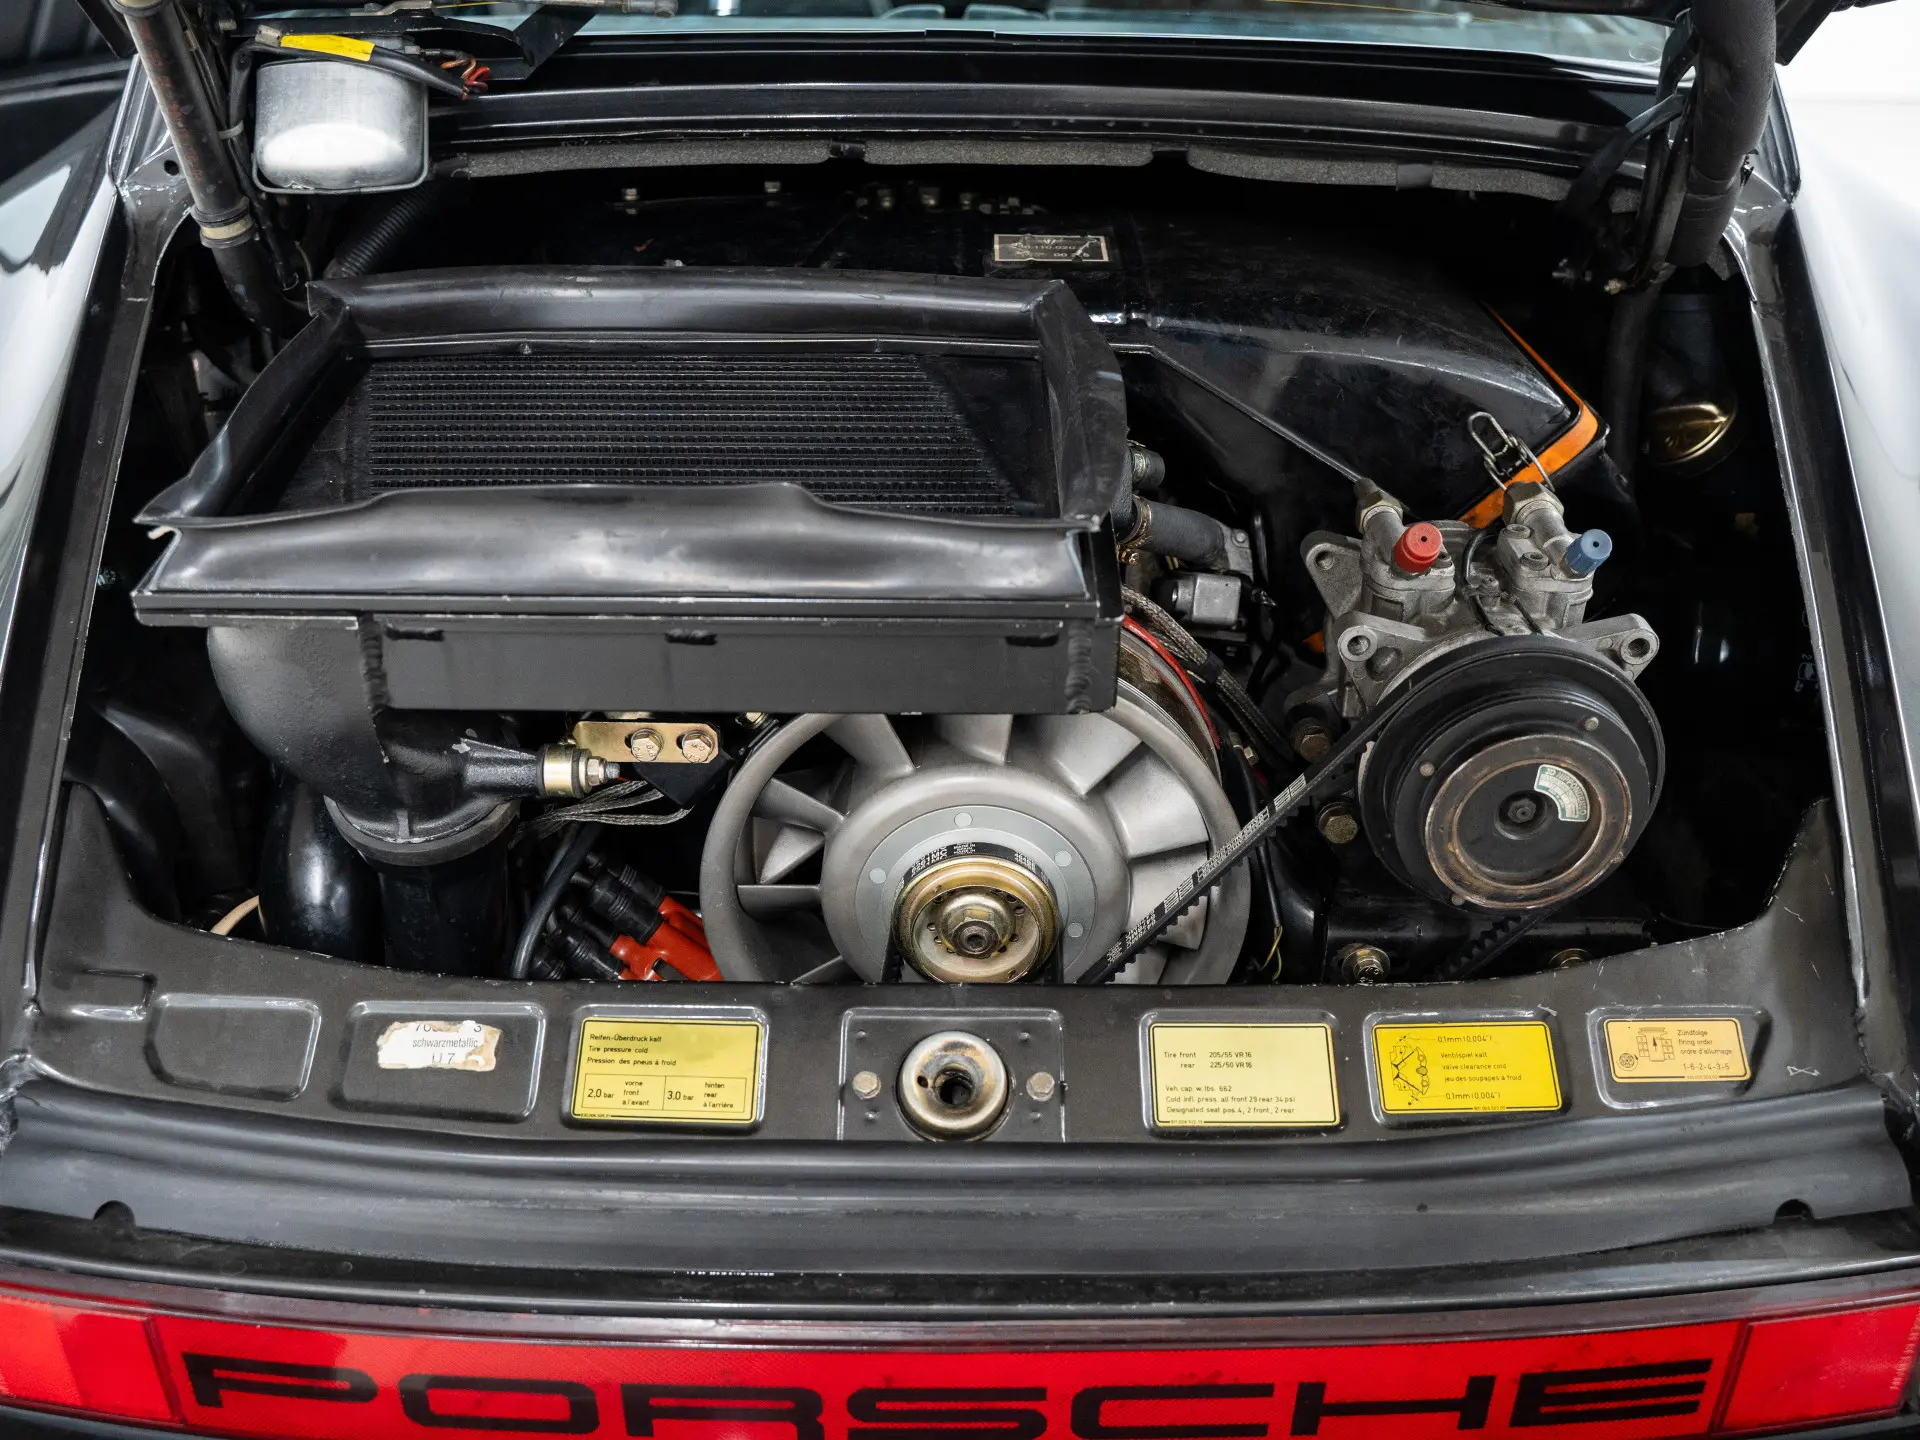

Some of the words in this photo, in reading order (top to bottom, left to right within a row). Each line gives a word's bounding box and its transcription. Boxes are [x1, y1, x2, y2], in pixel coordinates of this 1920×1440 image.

[1677, 1029, 1708, 1037] Zündfolge
[412, 1037, 479, 1048] schwarzmetallic
[589, 1033, 648, 1043] Reifen-Überdruck
[649, 1035, 662, 1043] kalt
[1678, 1038, 1696, 1046] firing
[1696, 1038, 1713, 1046] order
[588, 1045, 601, 1053] Tire
[603, 1046, 632, 1054] pressure
[634, 1046, 649, 1054] cold
[1163, 1051, 1177, 1059] Tire
[1179, 1051, 1197, 1059] front
[1209, 1050, 1233, 1059] 205/55
[1234, 1051, 1245, 1059] VR
[1440, 1052, 1474, 1060] Ventilspiel
[586, 1056, 616, 1065] Pression
[618, 1058, 631, 1066] des
[632, 1059, 653, 1067] pneus
[661, 1059, 677, 1067] froid
[1209, 1061, 1234, 1070] 225/50
[1235, 1061, 1245, 1069] VR
[1492, 1062, 1507, 1070] cold
[1444, 1075, 1455, 1083] jeu
[1468, 1075, 1500, 1083] soupapes
[1507, 1073, 1522, 1081] froid
[704, 1081, 725, 1089] hinten
[1218, 1085, 1232, 1093] 662
[623, 1088, 640, 1097] front
[682, 1093, 694, 1101] bar
[703, 1091, 718, 1099] rear
[1165, 1095, 1181, 1103] Cold
[1220, 1095, 1229, 1103] all
[1230, 1095, 1248, 1103] front
[1284, 1095, 1296, 1104] psi
[1166, 1106, 1204, 1115] Designated
[1206, 1106, 1221, 1114] seat
[183, 1352, 1713, 1440] PORSCHE
